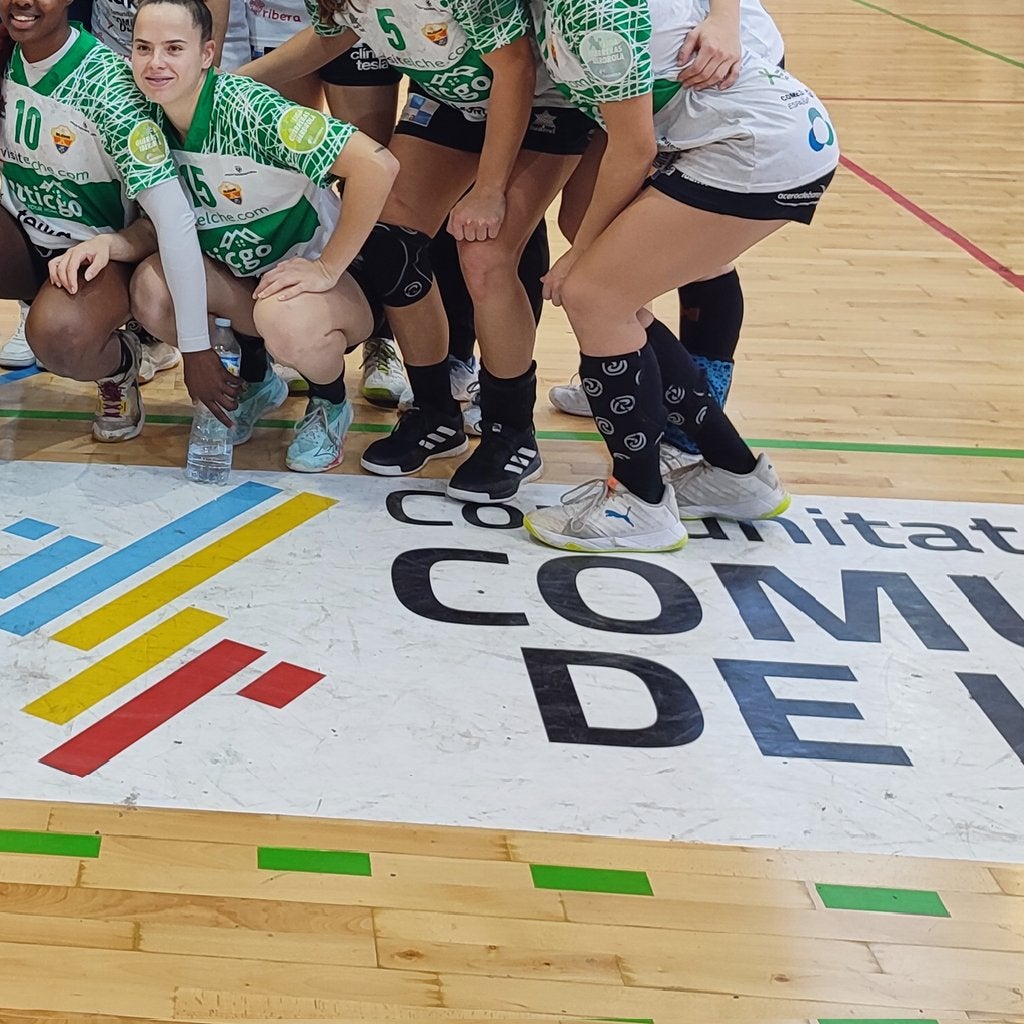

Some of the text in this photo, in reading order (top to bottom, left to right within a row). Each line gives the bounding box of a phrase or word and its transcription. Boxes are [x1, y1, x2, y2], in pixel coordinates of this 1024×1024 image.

[262, 9, 302, 23] ribera
[376, 8, 406, 51] 5
[15, 99, 42, 151] 10
[179, 164, 217, 208] 15
[385, 489, 1024, 555] Counitat
[520, 646, 914, 768] DE
